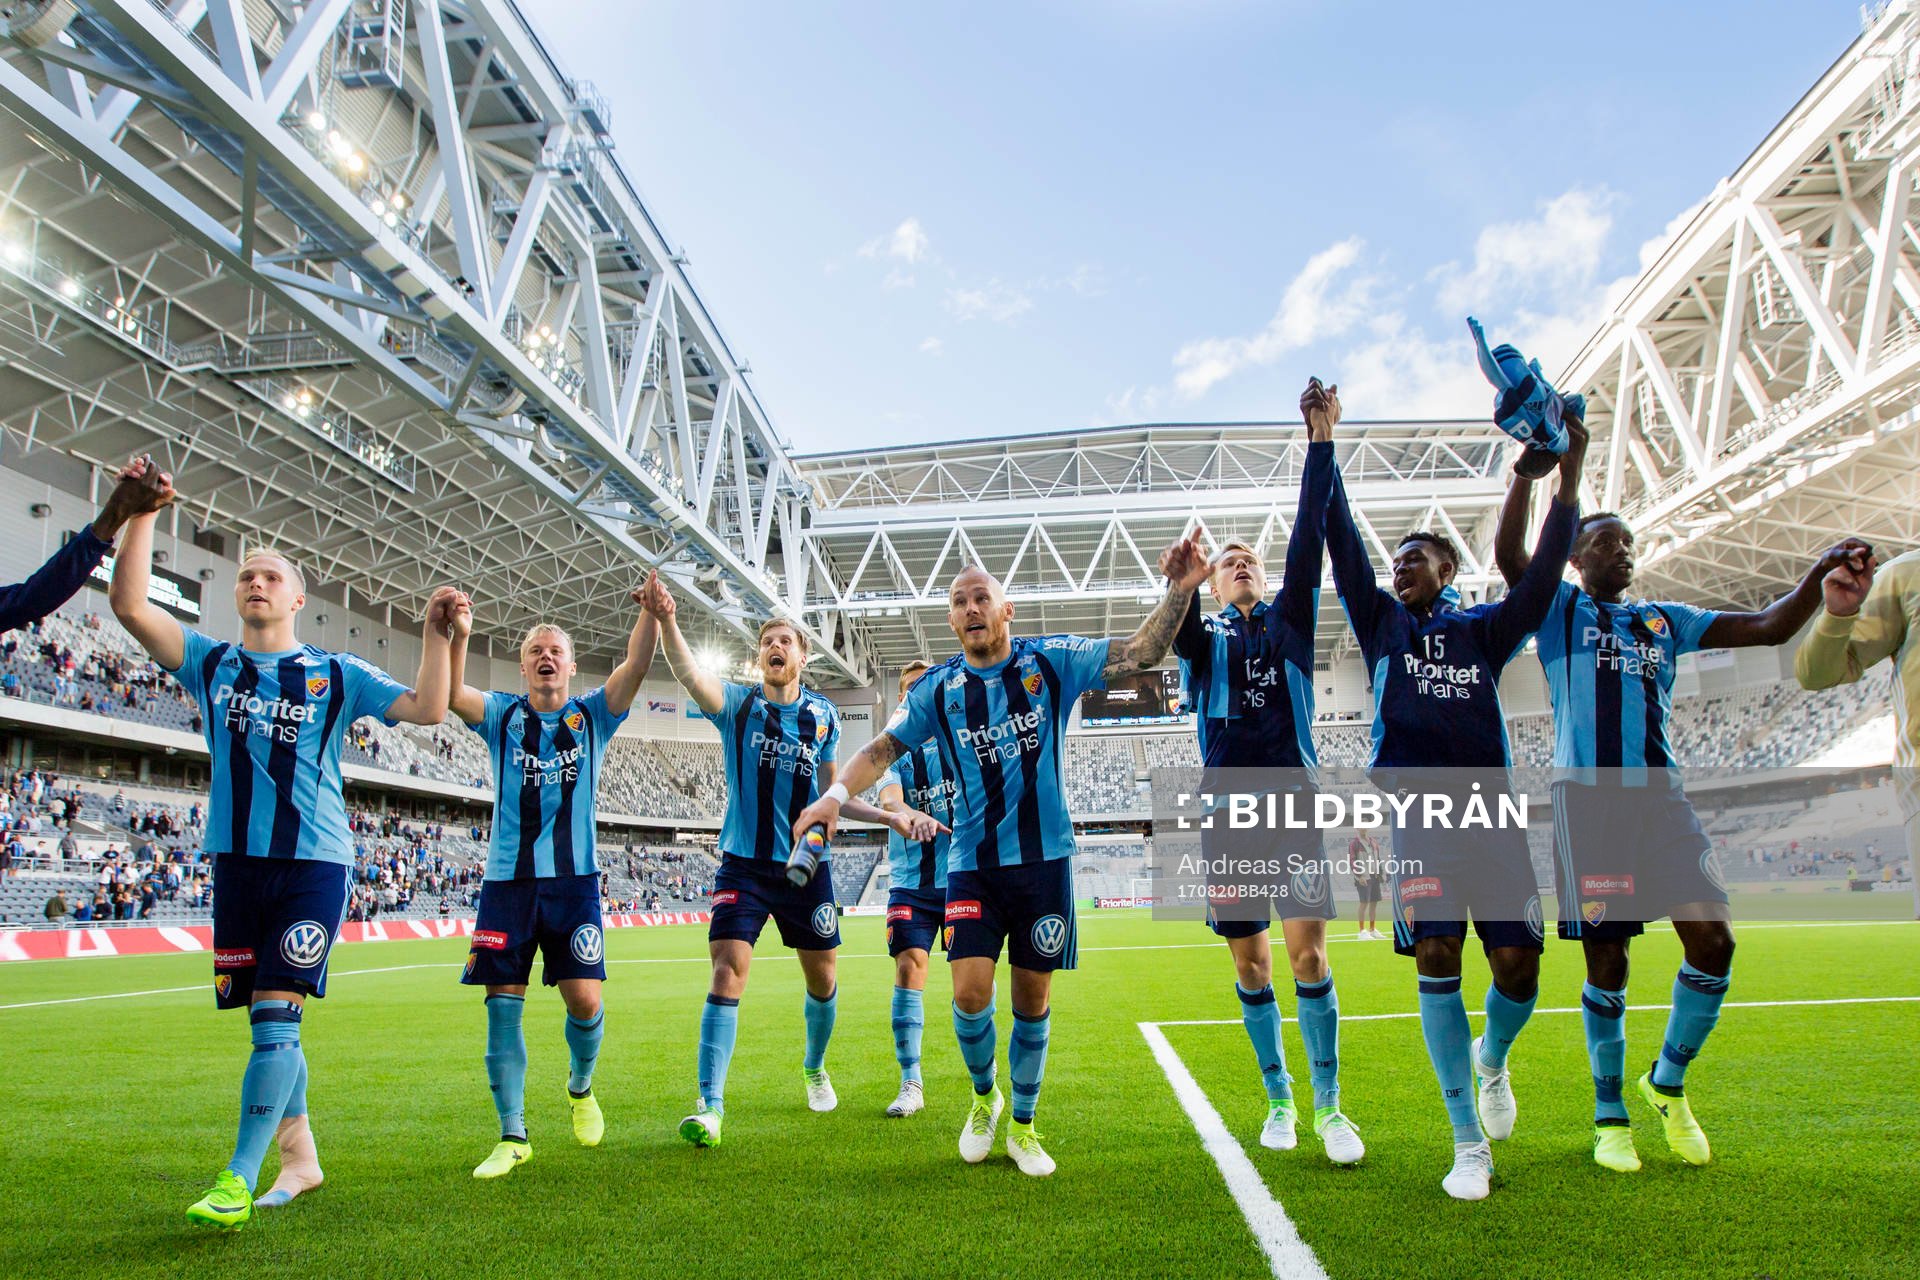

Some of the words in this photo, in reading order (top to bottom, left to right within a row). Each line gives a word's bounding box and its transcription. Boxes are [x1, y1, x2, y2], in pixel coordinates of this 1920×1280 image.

[1423, 635, 1445, 660] 15
[1596, 649, 1660, 679] Finans
[214, 684, 318, 724] Prioritet
[224, 708, 298, 743] Finans
[840, 712, 869, 721] Arena
[956, 704, 1047, 748] Prioritet
[974, 733, 1040, 767] Finans
[759, 751, 813, 776] Finans
[522, 766, 579, 787] Finans
[908, 779, 958, 802] Priorite
[917, 797, 954, 814] Finan
[1585, 880, 1629, 889] Moderna
[1445, 1088, 1464, 1098] DIF
[249, 1104, 276, 1116] DIF
